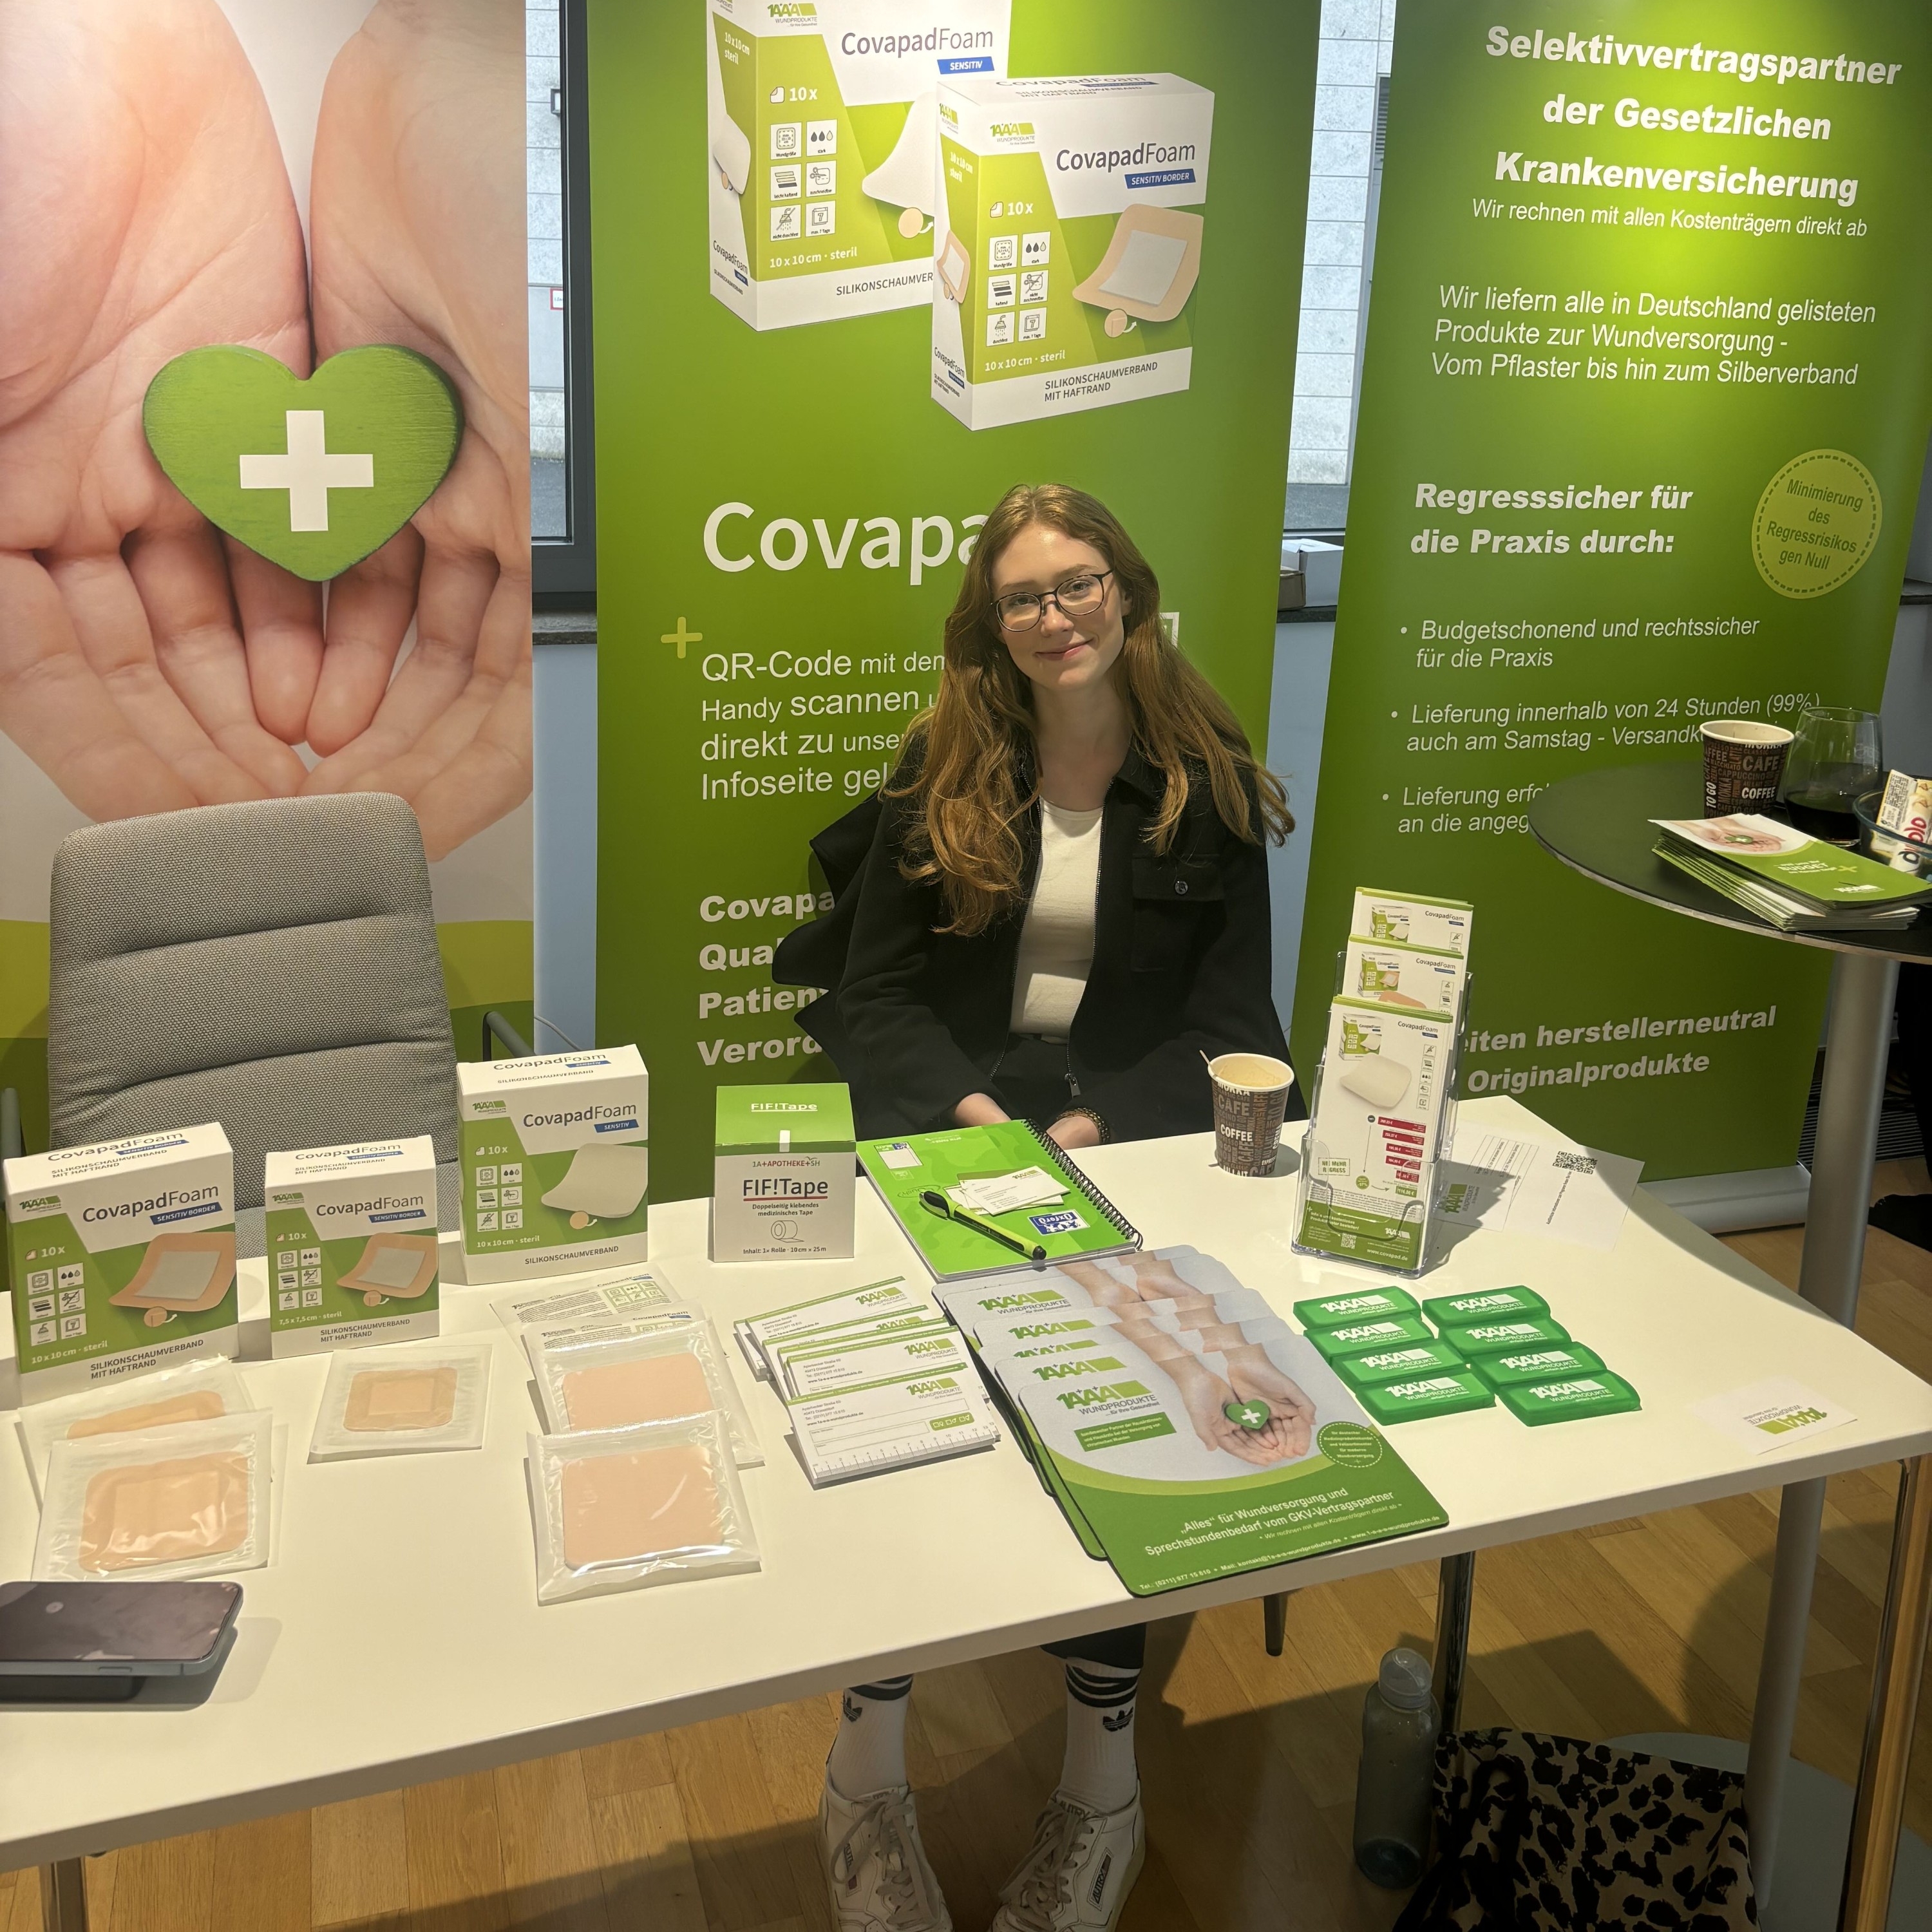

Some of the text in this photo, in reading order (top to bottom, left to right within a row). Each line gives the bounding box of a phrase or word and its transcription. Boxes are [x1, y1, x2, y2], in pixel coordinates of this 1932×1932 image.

[841, 27, 994, 58] CovapadFoam
[949, 60, 983, 71] SENSITIV
[1486, 26, 1902, 85] Selektivvertragspartner
[1544, 93, 1831, 140] der Gesetzlichen
[1056, 142, 1195, 173] CovapadFoam
[1131, 172, 1190, 185] SENSITIV BORDER
[1495, 151, 1859, 207] Krankenversicherung
[1472, 198, 1867, 236] Wir rechnen mit allen Kostenträgern direkt ab
[830, 247, 857, 260] steril
[1439, 285, 1876, 325] Wir liefern alle in Deutschland gelisteten
[1435, 319, 1774, 356] Produkte zur Wundversorgung
[1040, 350, 1065, 363] steril
[1045, 362, 1157, 390] SILIKONSCHAUMVERBAND
[1432, 353, 1859, 384] Vom Pflaster bis hin zum Silberverband
[1045, 383, 1110, 402] MIT HAFTRAND
[1415, 483, 1694, 515] Regresssicher für
[1786, 477, 1864, 513] Minimierung
[1807, 507, 1830, 526] des
[1410, 529, 1674, 554] die Praxis durch:
[1766, 519, 1857, 555] Regressrisikos
[1778, 549, 1831, 571] gen Null
[1421, 617, 1760, 643] Budgetschonend und rechtssicher
[702, 649, 852, 682] QR-Code
[860, 652, 896, 674] mit
[1416, 647, 1553, 668] für die Praxis
[701, 697, 781, 723] Handy
[790, 690, 919, 716] scannen
[1410, 702, 1510, 728] Lieferung
[1515, 700, 1608, 723] innerhalb
[1614, 701, 1649, 720] von
[1654, 699, 1680, 718] 24
[1685, 696, 1761, 717] Stunden
[701, 731, 905, 761] direkt zu unse
[1406, 724, 1703, 754] auch am Samstag Versandk
[701, 767, 833, 800] Infoseite
[1741, 786, 1776, 799] COFFEE
[1403, 784, 1500, 808] Lieferung
[1397, 816, 1424, 833] an
[1430, 813, 1462, 833] die
[1425, 911, 1464, 922] CovapadFoam
[699, 938, 784, 971] Qua
[1416, 958, 1455, 969] CovapadFoam
[699, 987, 829, 1019] Patien
[1397, 1021, 1438, 1033] CovapadFoam
[1536, 1005, 1776, 1048] herstellerneutral
[493, 1054, 606, 1070] CovapadFoam
[1468, 1052, 1710, 1094] Originalprodukte
[524, 1104, 636, 1128] CovapadFoam
[751, 1103, 818, 1111] FIF!Tape
[604, 1122, 630, 1130] SENSITIV
[1221, 1124, 1253, 1142] COFFEE
[48, 1132, 183, 1161] CovapadFoam
[296, 1144, 401, 1160] CovapadFoam
[743, 1178, 828, 1198] FIF!Tape
[83, 1186, 218, 1222] CovapadFoam
[157, 1205, 216, 1222] SENSITIV BORDER
[316, 1196, 423, 1216] CovapadFoam
[1038, 1211, 1073, 1224] Oxford
[525, 1245, 619, 1265] SILIKONSCHAUMVERBAND
[1367, 1248, 1408, 1261] www.covapad.de
[998, 1299, 1070, 1314] WUNDPRODUKTE
[1338, 1302, 1396, 1315] WUNDPRODUKTE
[1468, 1302, 1524, 1314] WUNDPRODUKTE
[321, 1319, 410, 1336] SILIKONSCHAUMVERBAND
[335, 1331, 372, 1341] HAFTRAND
[1350, 1329, 1408, 1343] WUNDPRODUKTE
[91, 1340, 204, 1371] SILIKONSCHAUMVERBAND
[91, 1359, 156, 1379] MIT HAFTRAND
[1405, 1386, 1467, 1401] WUNDPRODUKTE
[1079, 1394, 1157, 1415] WUNDPRODUKTE
[1130, 1401, 1160, 1411] Gesundheit
[1218, 1512, 1234, 1524] für
[1235, 1491, 1328, 1520] Wundversorgung
[1329, 1487, 1349, 1500] und
[1145, 1491, 1395, 1556] Sprechstundenbedarf vom GKV-Vertragspartner
